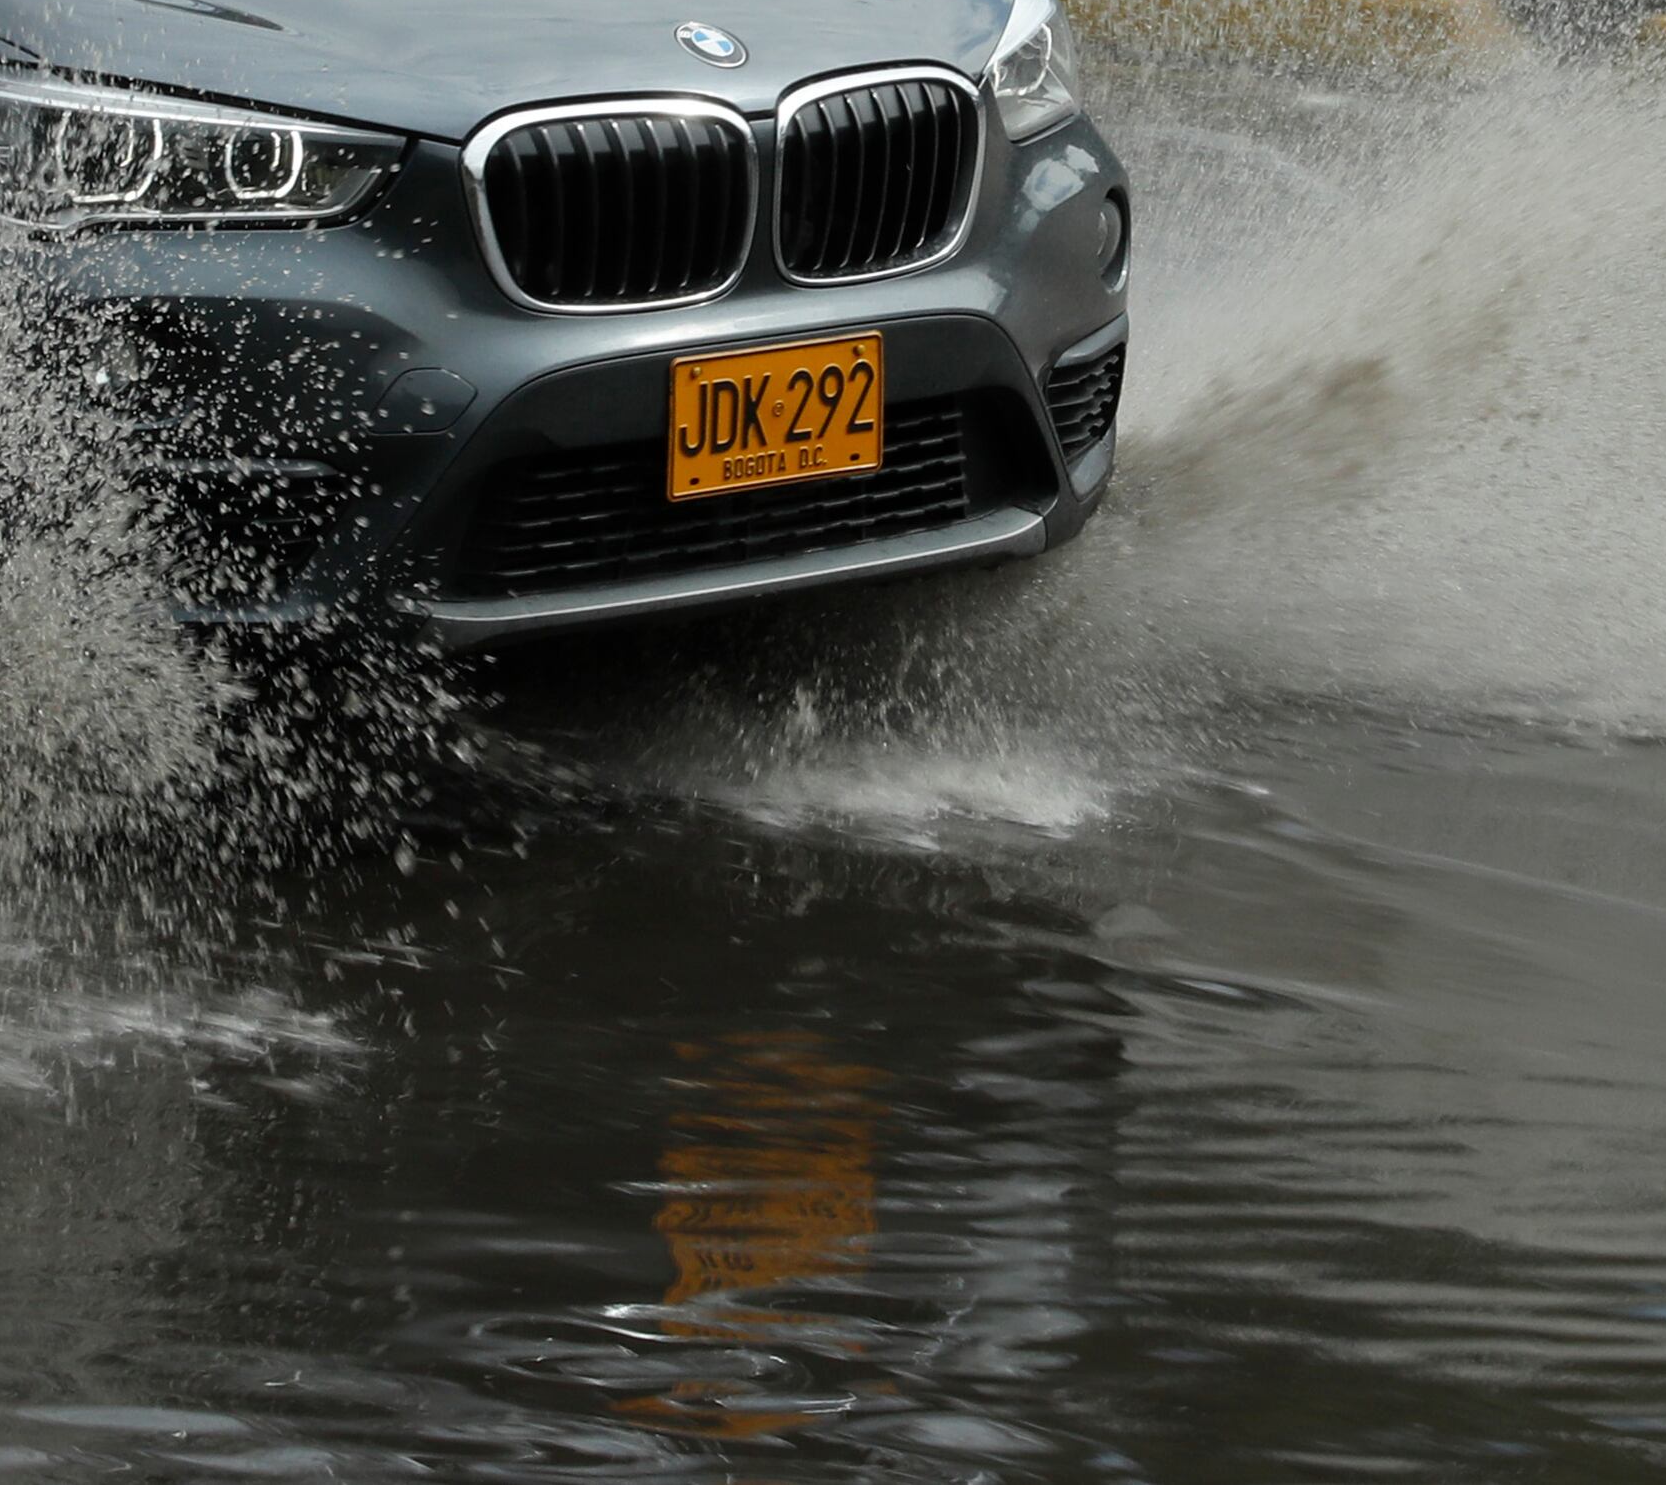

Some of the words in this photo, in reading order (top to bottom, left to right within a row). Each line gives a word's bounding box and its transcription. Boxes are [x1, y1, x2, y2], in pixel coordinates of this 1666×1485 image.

[679, 373, 771, 457] JDK
[785, 360, 875, 444] 292
[723, 451, 786, 481] BOGOTA
